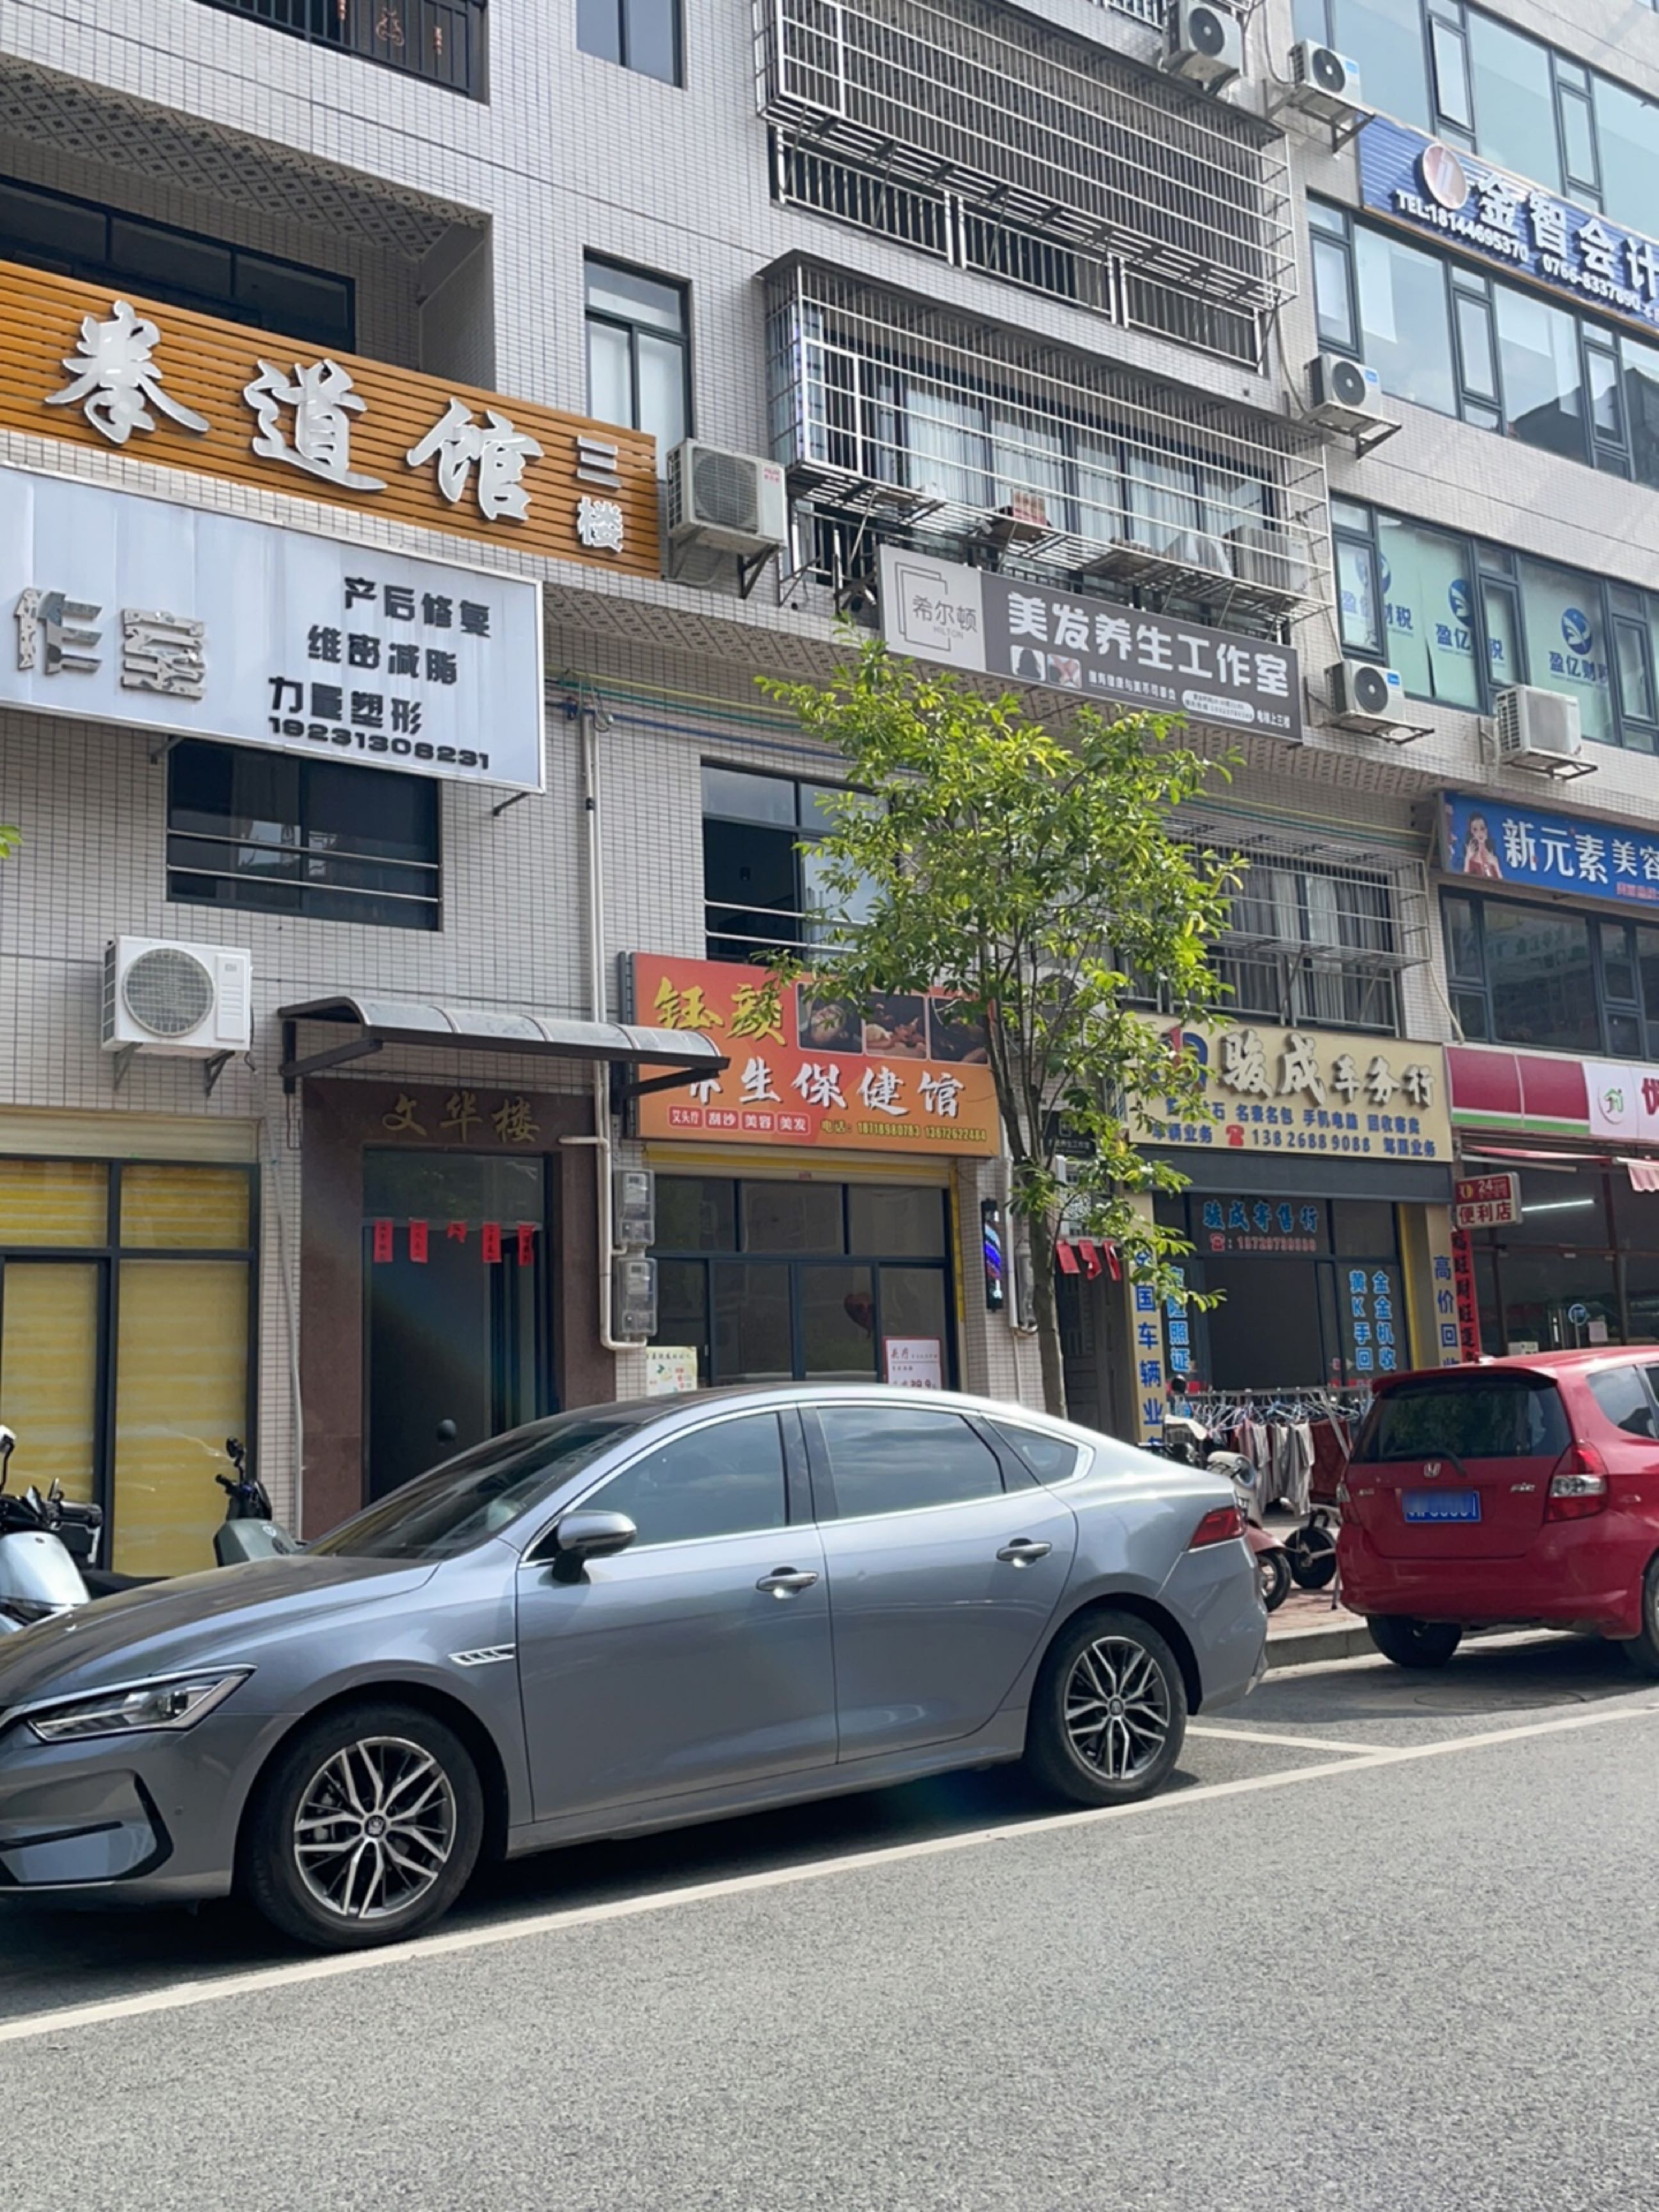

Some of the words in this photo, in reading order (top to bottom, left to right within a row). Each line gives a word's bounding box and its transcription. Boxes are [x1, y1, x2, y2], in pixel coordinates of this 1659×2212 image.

[1477, 172, 1659, 299] 金智会计
[45, 299, 544, 520] 拳道馆
[344, 577, 490, 638] 产后修复
[912, 595, 978, 633] 希尔顿
[14, 588, 206, 701] 作室
[308, 625, 457, 685] 维密减脂
[1007, 591, 1289, 698] 美发养生工作室
[268, 677, 422, 734] 力量塑形
[268, 716, 490, 769] 18231308231
[1502, 819, 1659, 885] 新元素美容
[1220, 1029, 1435, 1108] 骏成车务行
[383, 1091, 540, 1143] 文华楼
[1460, 1201, 1511, 1225] 便利店
[1135, 1251, 1164, 1445] 全国车辆业
